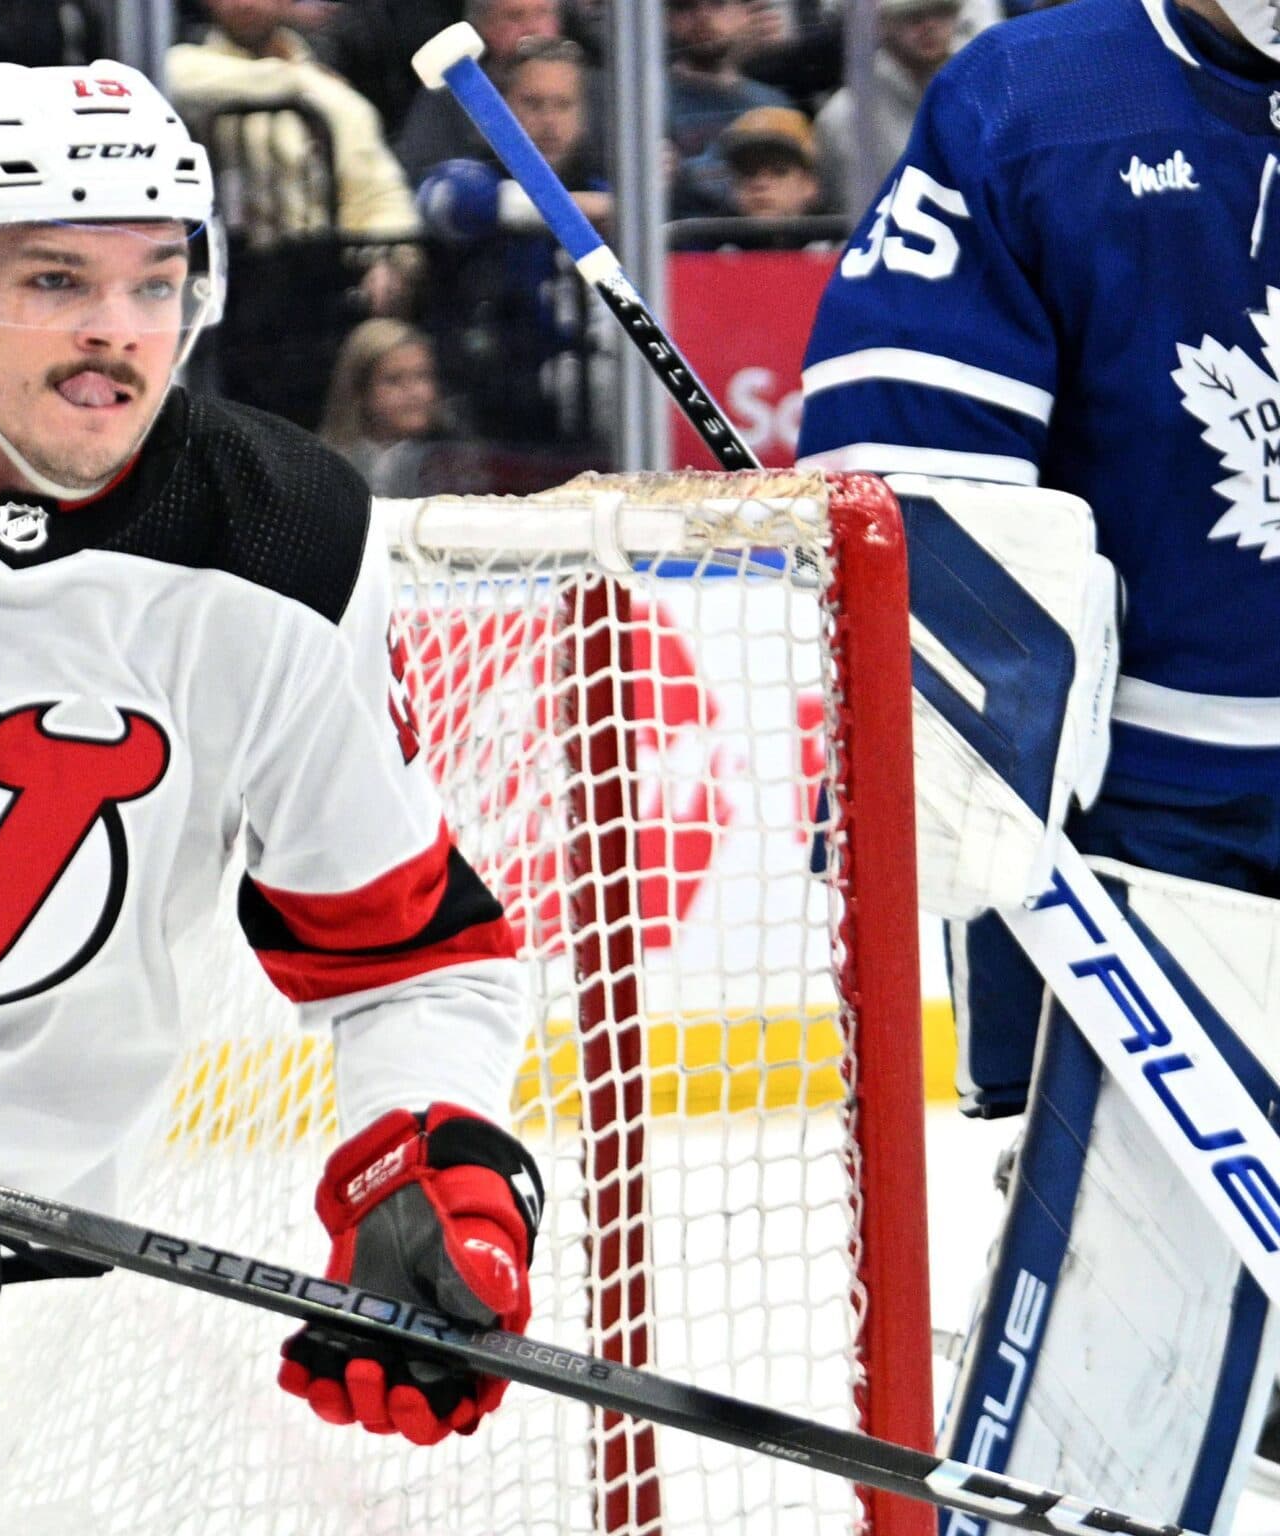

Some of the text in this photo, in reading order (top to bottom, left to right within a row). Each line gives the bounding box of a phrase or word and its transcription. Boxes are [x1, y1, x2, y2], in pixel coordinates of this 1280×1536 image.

[67, 143, 157, 160] CCM
[1120, 149, 1200, 197] Milk
[1031, 865, 1280, 1253] TRUE
[136, 1231, 453, 1342] RIBCOR
[589, 1363, 611, 1381] 8
